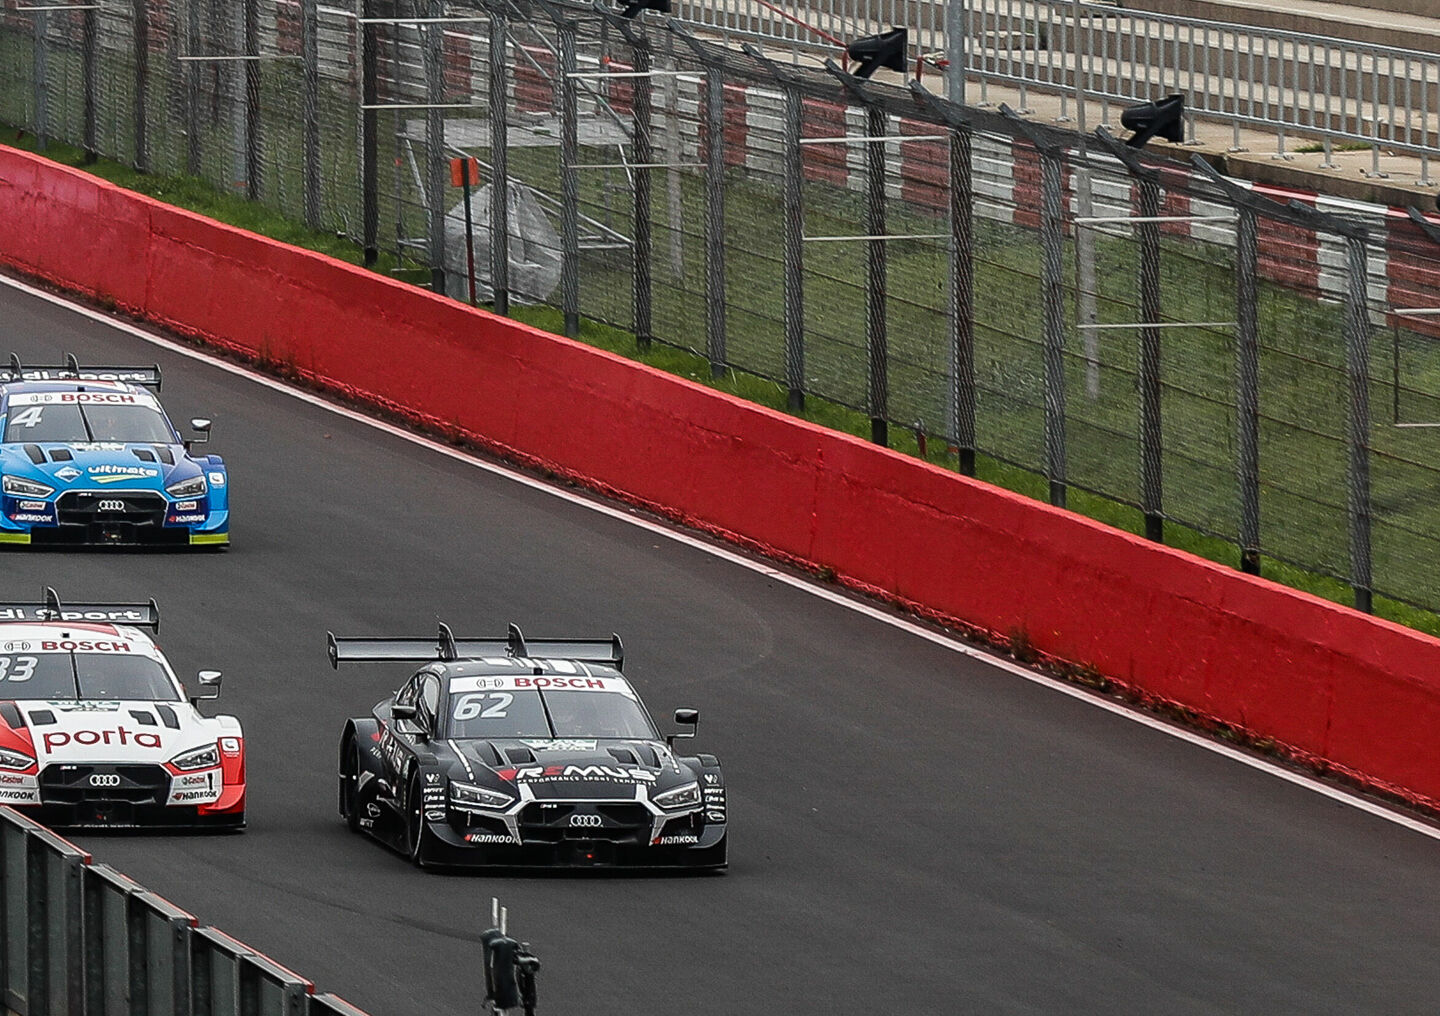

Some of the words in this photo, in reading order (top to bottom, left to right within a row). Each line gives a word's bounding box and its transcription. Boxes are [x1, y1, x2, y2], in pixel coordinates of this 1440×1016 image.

[61, 393, 136, 404] BOSCH
[9, 406, 45, 428] 4
[87, 465, 158, 477] ultimate
[41, 640, 131, 653] BOSCH
[513, 677, 606, 690] BOSCH
[453, 692, 514, 721] 62
[43, 725, 162, 754] porta
[1, 774, 24, 785] Castrol
[516, 765, 657, 782] REMUS
